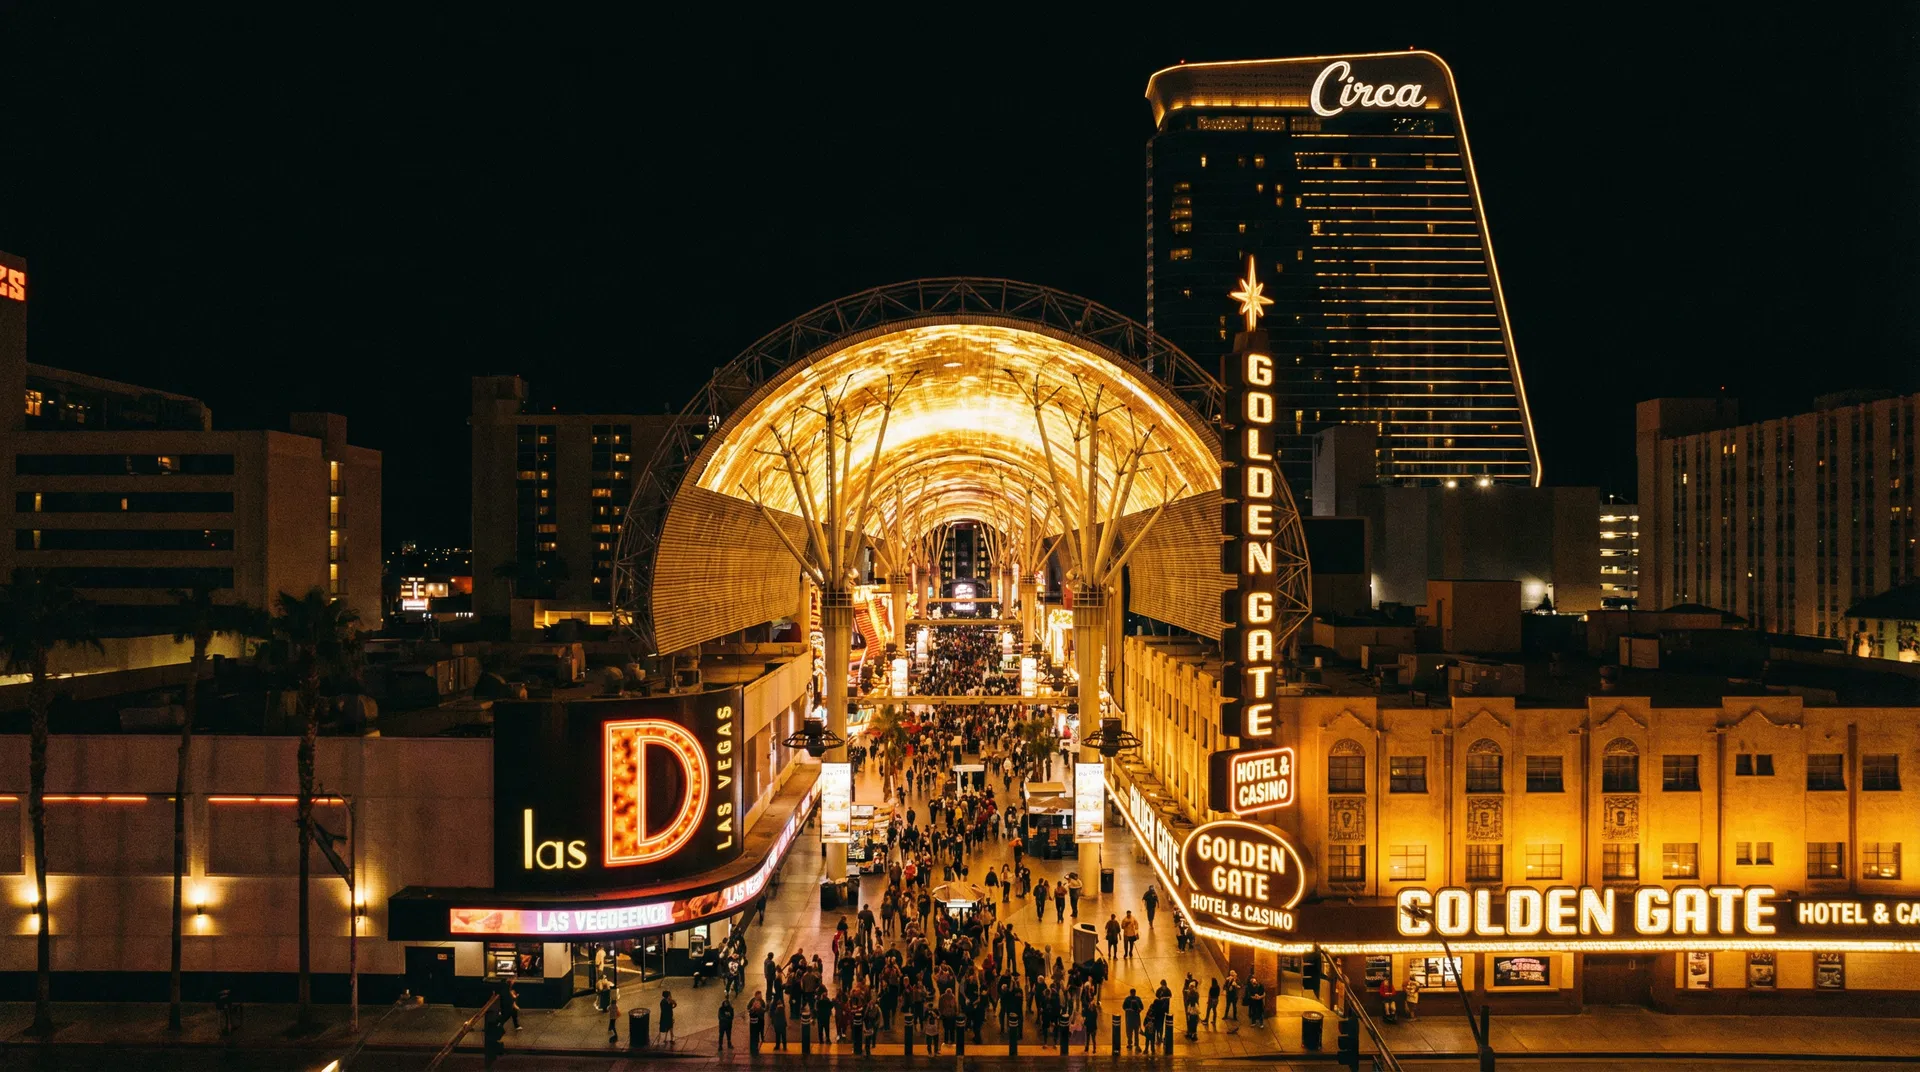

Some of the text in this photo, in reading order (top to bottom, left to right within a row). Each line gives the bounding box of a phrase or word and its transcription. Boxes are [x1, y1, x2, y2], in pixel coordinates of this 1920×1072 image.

[1310, 61, 1427, 117] Circa
[1248, 353, 1273, 736] GOLDEN GATE
[717, 705, 732, 850] LAS VEGAS
[1237, 755, 1290, 784] HOTEL &
[524, 717, 710, 870] las D
[1239, 778, 1288, 807] CASINO
[1156, 817, 1180, 886] GATE
[1196, 833, 1286, 875] GOLDEN
[1211, 865, 1270, 901] GATE
[537, 912, 570, 932] LAS
[1190, 893, 1293, 931] HOTEL & CASINO
[1397, 885, 1776, 936] GOLDEN GATE
[1799, 902, 1868, 925] HOTEL
[1873, 902, 1890, 925] &
